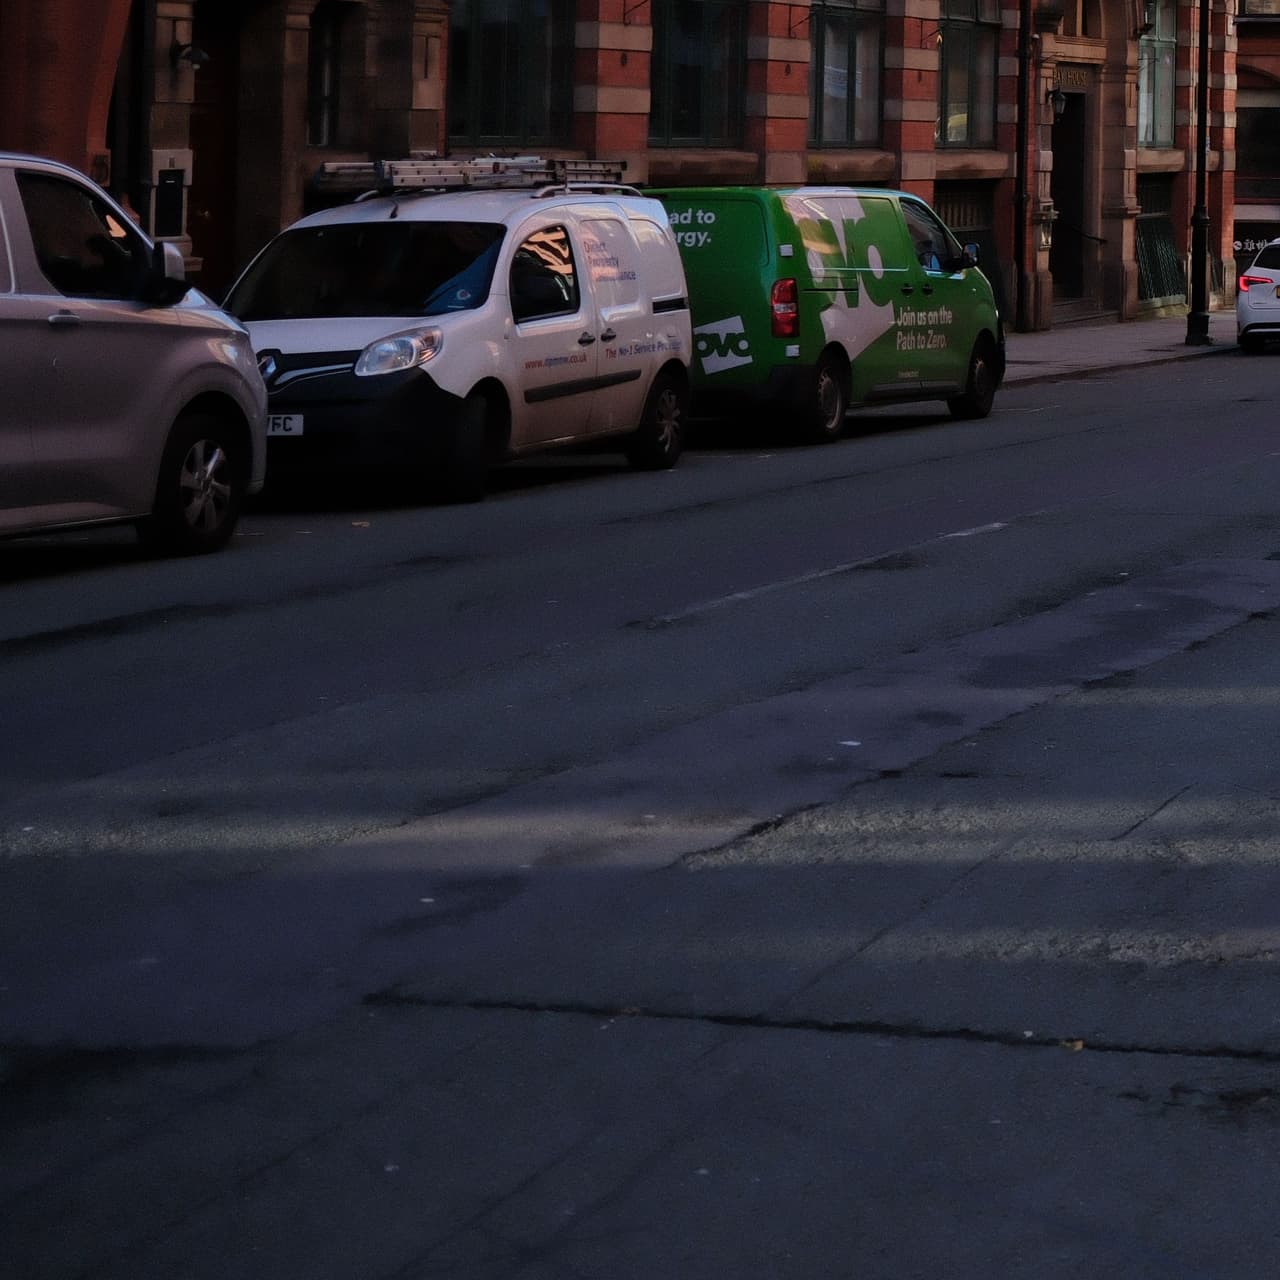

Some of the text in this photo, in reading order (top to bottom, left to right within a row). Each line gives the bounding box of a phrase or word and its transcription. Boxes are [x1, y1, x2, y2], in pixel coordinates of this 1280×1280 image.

[696, 209, 716, 224] to
[897, 305, 953, 327] Join us on the
[897, 330, 916, 351] Path
[917, 332, 926, 350] to
[605, 347, 617, 359] The
[634, 342, 655, 355] Service
